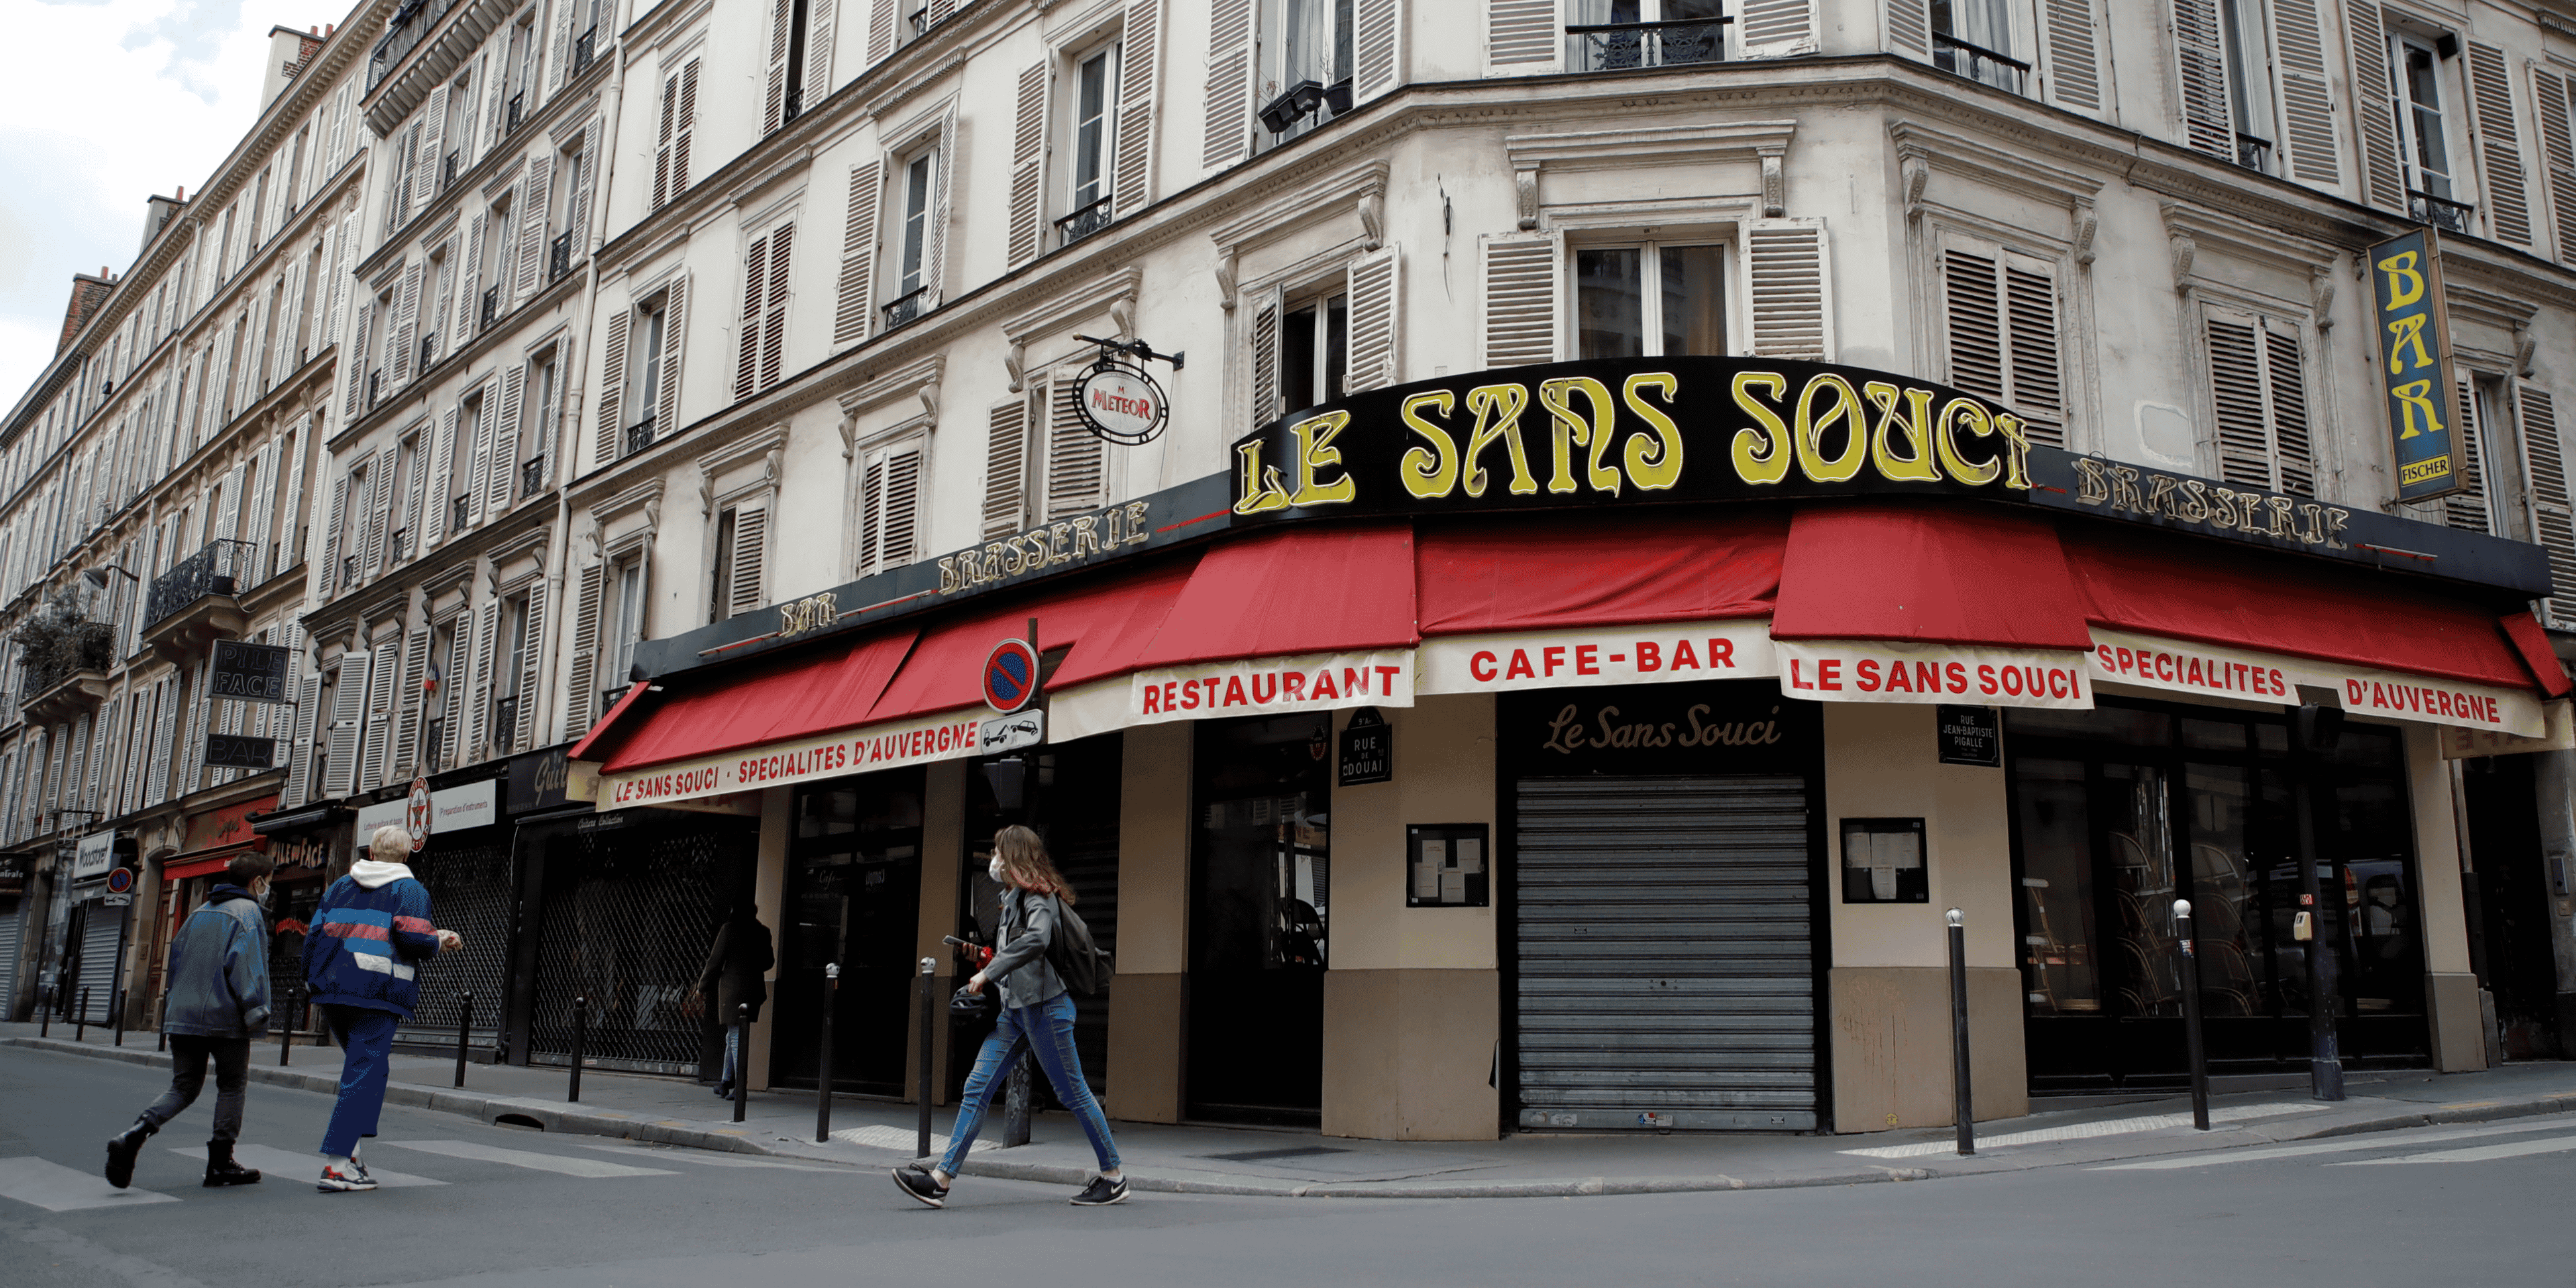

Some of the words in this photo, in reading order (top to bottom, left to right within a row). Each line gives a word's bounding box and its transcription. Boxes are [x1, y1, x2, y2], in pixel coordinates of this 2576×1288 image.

[2377, 250, 2444, 439] BAR
[1091, 388, 1151, 421] METEOR
[1233, 410, 1356, 515] LE
[1400, 372, 1684, 498] SANS
[1731, 371, 2031, 490] SOUCI
[2402, 460, 2448, 481] FISCHER
[2071, 458, 2348, 550] BRASSERIE
[938, 501, 1150, 595] BRASSERIE
[780, 593, 837, 637] BAR
[219, 646, 285, 672] PILE
[1470, 639, 1735, 682] CAFE-BAR
[215, 672, 281, 698] FACE
[1142, 666, 1400, 715] RESTAURANT
[1790, 659, 1843, 691] LE
[1856, 659, 1968, 694] SANS
[1977, 664, 2080, 699] SOUCI
[2097, 644, 2286, 696] SPECIALITES
[2346, 678, 2501, 723] D'AUVERGNE
[1543, 704, 1585, 754] Le
[1589, 705, 1676, 748] Sans
[1678, 704, 1782, 747] Souci
[1943, 724, 1993, 738] JEAN-BAPTISTE
[1960, 714, 1974, 725] RUE
[209, 739, 270, 763] BAR
[1354, 737, 1376, 751] RUE
[1954, 736, 1983, 748] PIGALLE
[616, 781, 634, 802] LE
[635, 775, 672, 799] SANS
[676, 767, 719, 794] SOUCI
[739, 745, 846, 783] SPECIALITES
[853, 721, 977, 765] D'AUVERGNE
[1348, 759, 1382, 775] DOUAI
[300, 837, 323, 869] FACE
